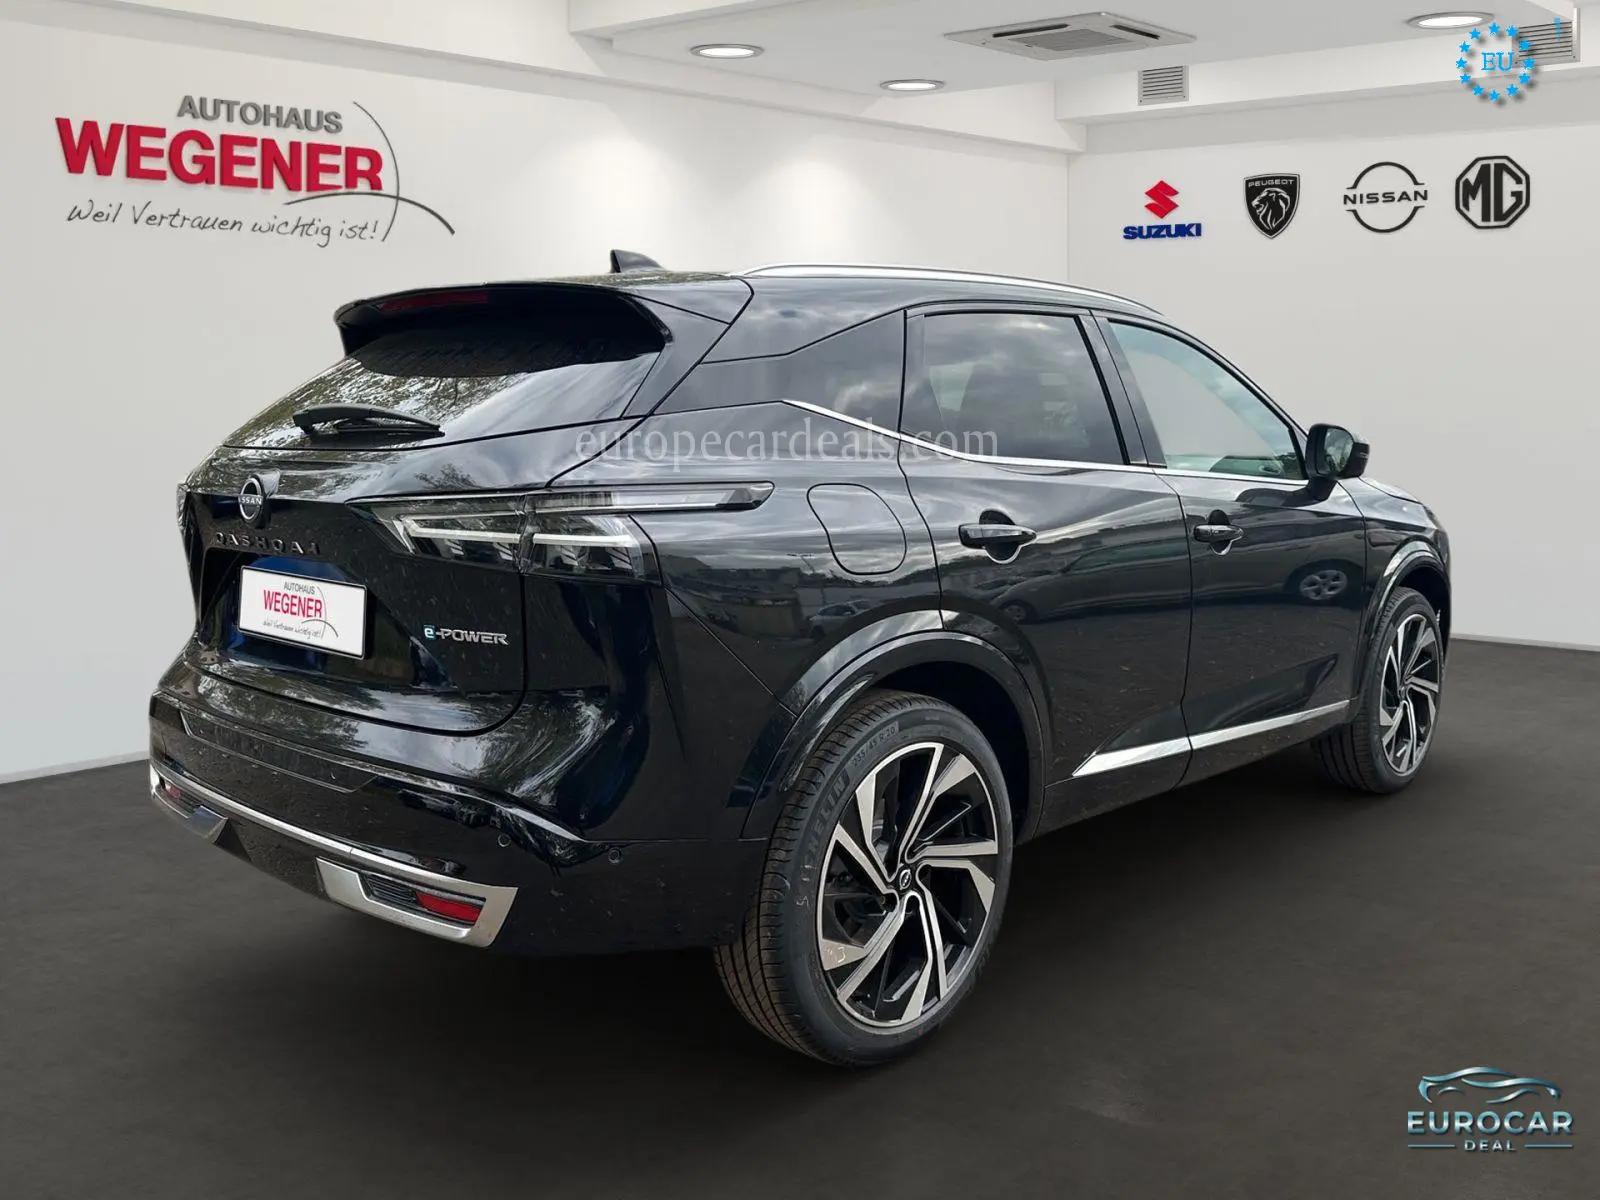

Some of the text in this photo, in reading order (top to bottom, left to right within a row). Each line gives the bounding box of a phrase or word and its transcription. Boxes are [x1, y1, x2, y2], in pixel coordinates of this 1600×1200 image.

[177, 95, 343, 134] AUTOHAUS
[55, 117, 383, 193] WEGENER
[1248, 179, 1295, 188] PEUGEOT
[1462, 162, 1525, 224] MG
[1343, 189, 1428, 206] NISSAN
[67, 199, 120, 223] Weil
[132, 201, 244, 232] Vertrauen
[250, 215, 333, 247] wichtig
[1123, 223, 1202, 240] SUZUKI
[284, 581, 316, 595] AUTOHAUS
[263, 589, 323, 618] WEGENER
[423, 625, 509, 646] e-POWER
